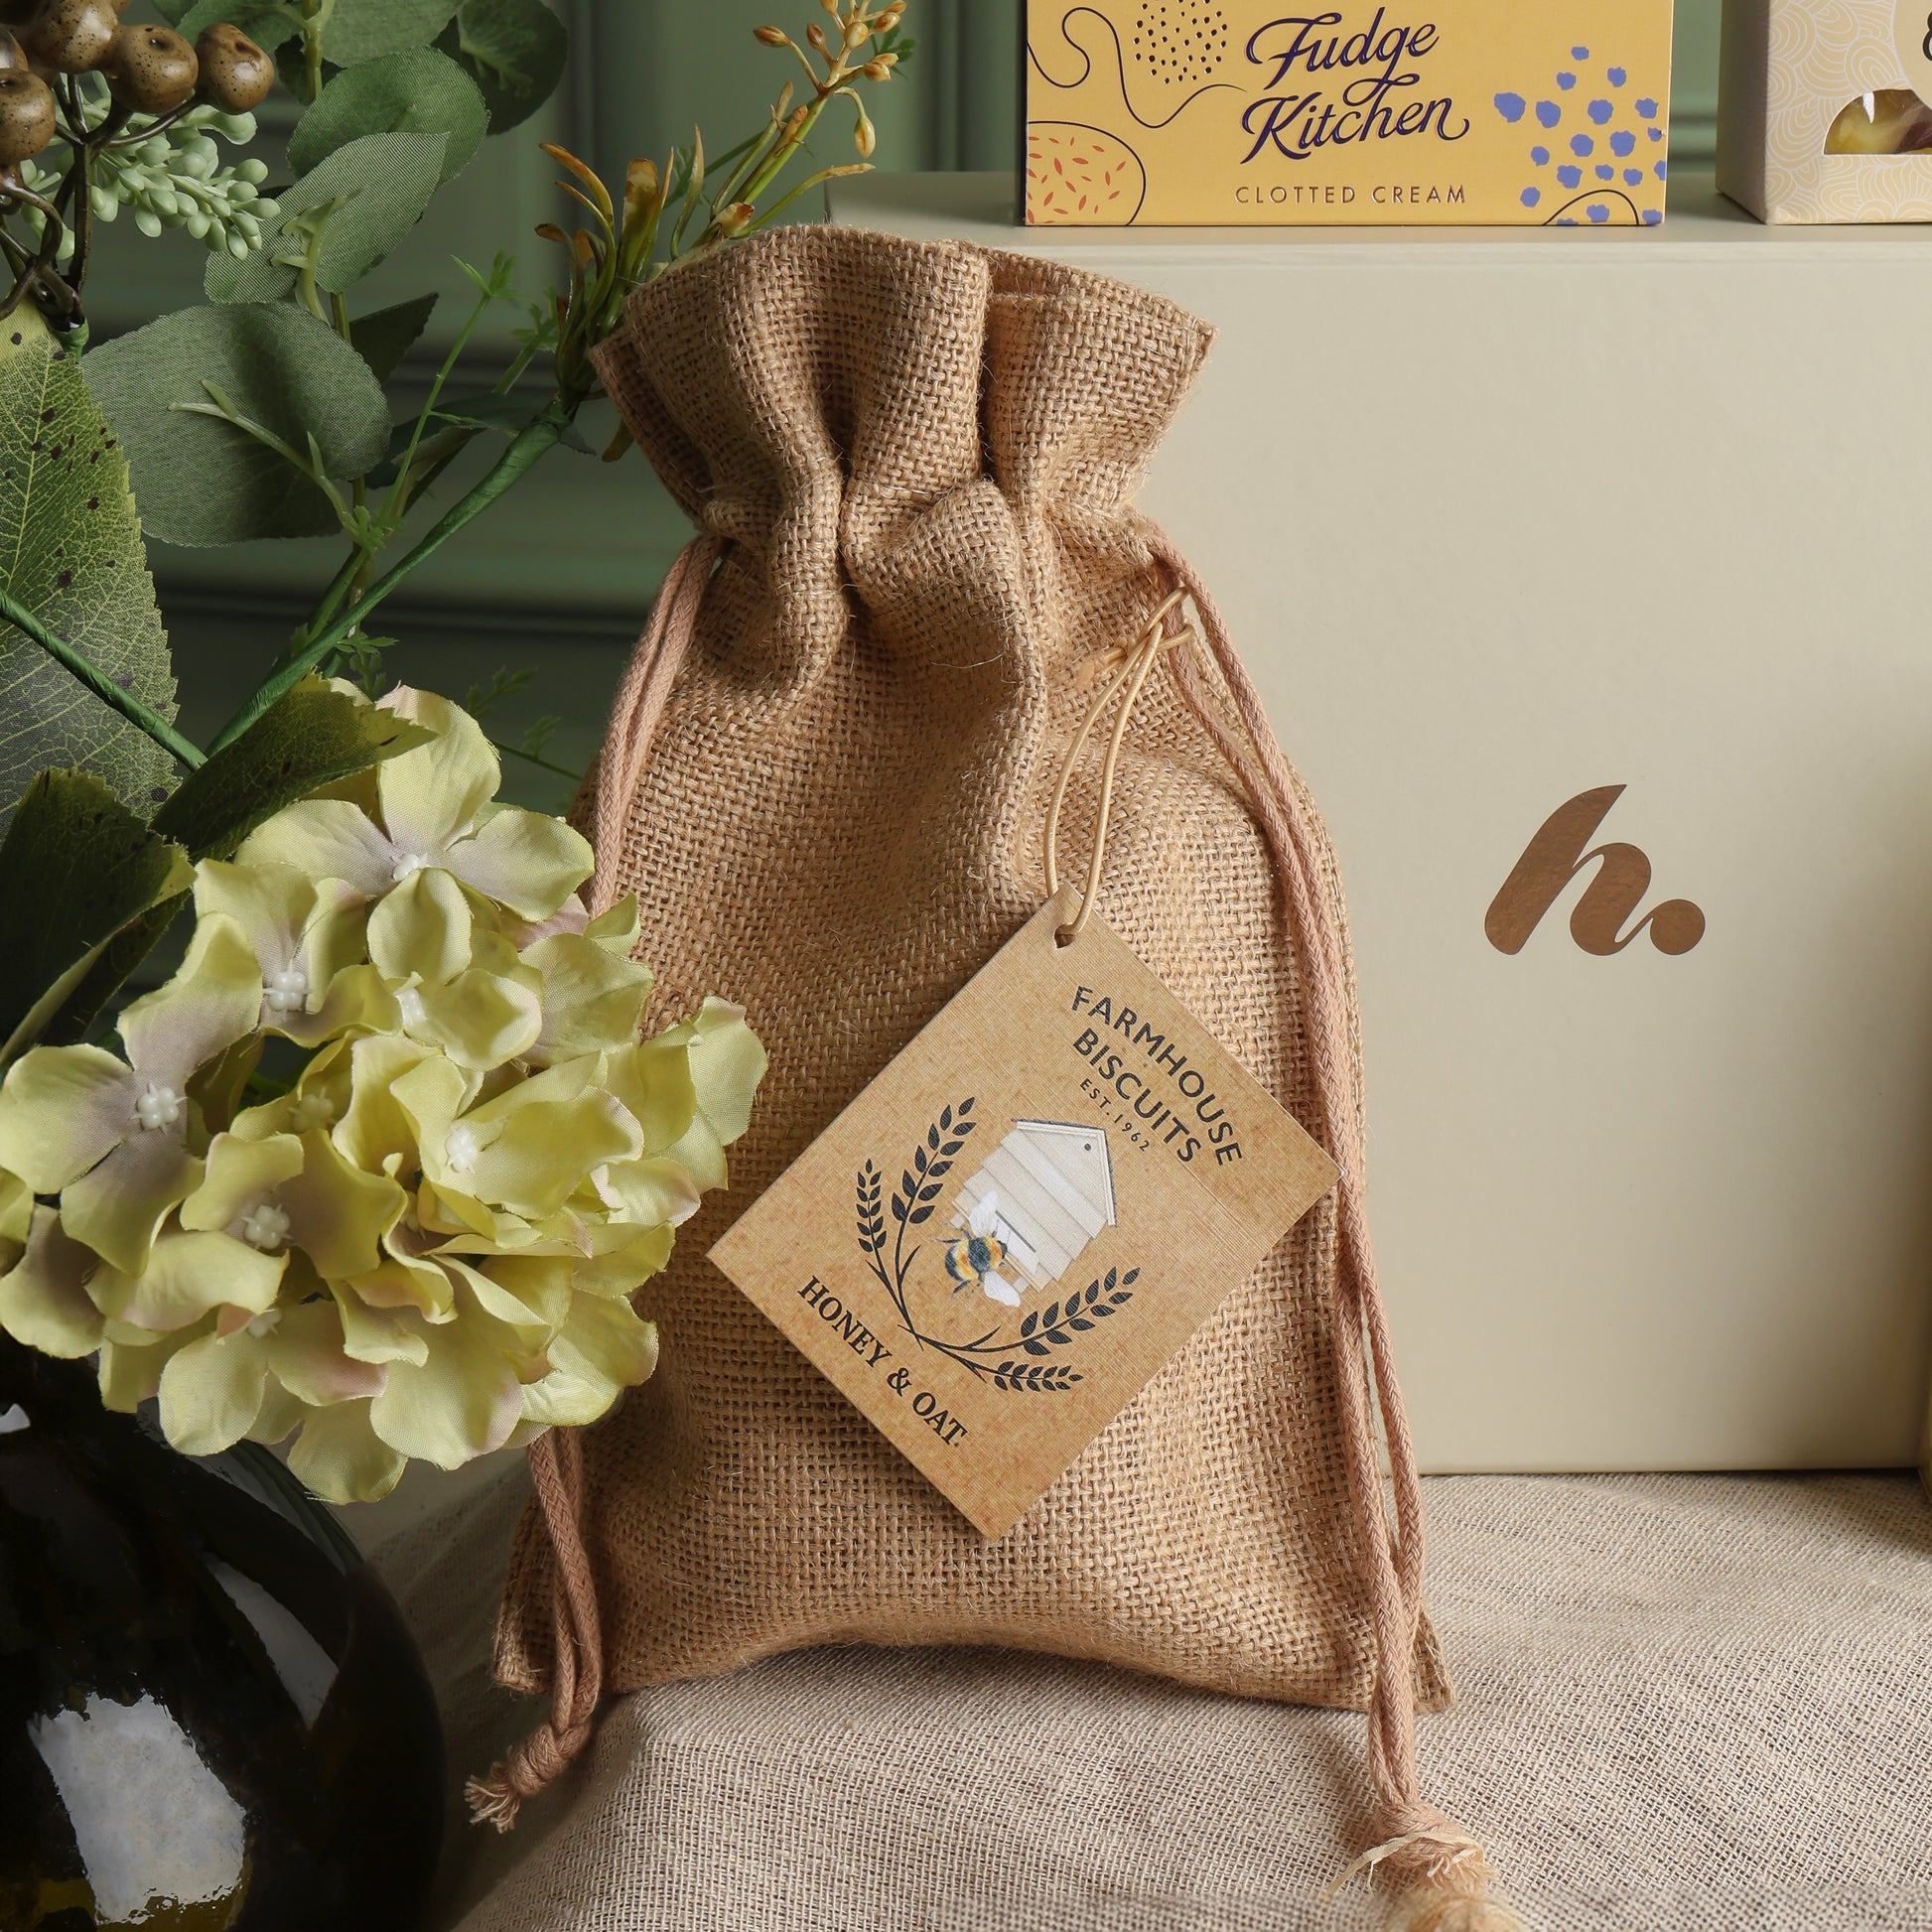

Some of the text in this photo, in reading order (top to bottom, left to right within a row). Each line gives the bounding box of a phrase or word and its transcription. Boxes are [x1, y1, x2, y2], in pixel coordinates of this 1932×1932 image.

[1245, 6, 1440, 107] Fudge
[1240, 72, 1470, 165] Kitchen
[1234, 185, 1466, 205] CLOTTED CREAM
[1071, 985, 1243, 1167] FARMHOUSE
[1072, 1027, 1202, 1163] BISCUITS
[797, 1275, 893, 1368] HONEY
[887, 1367, 912, 1398] &
